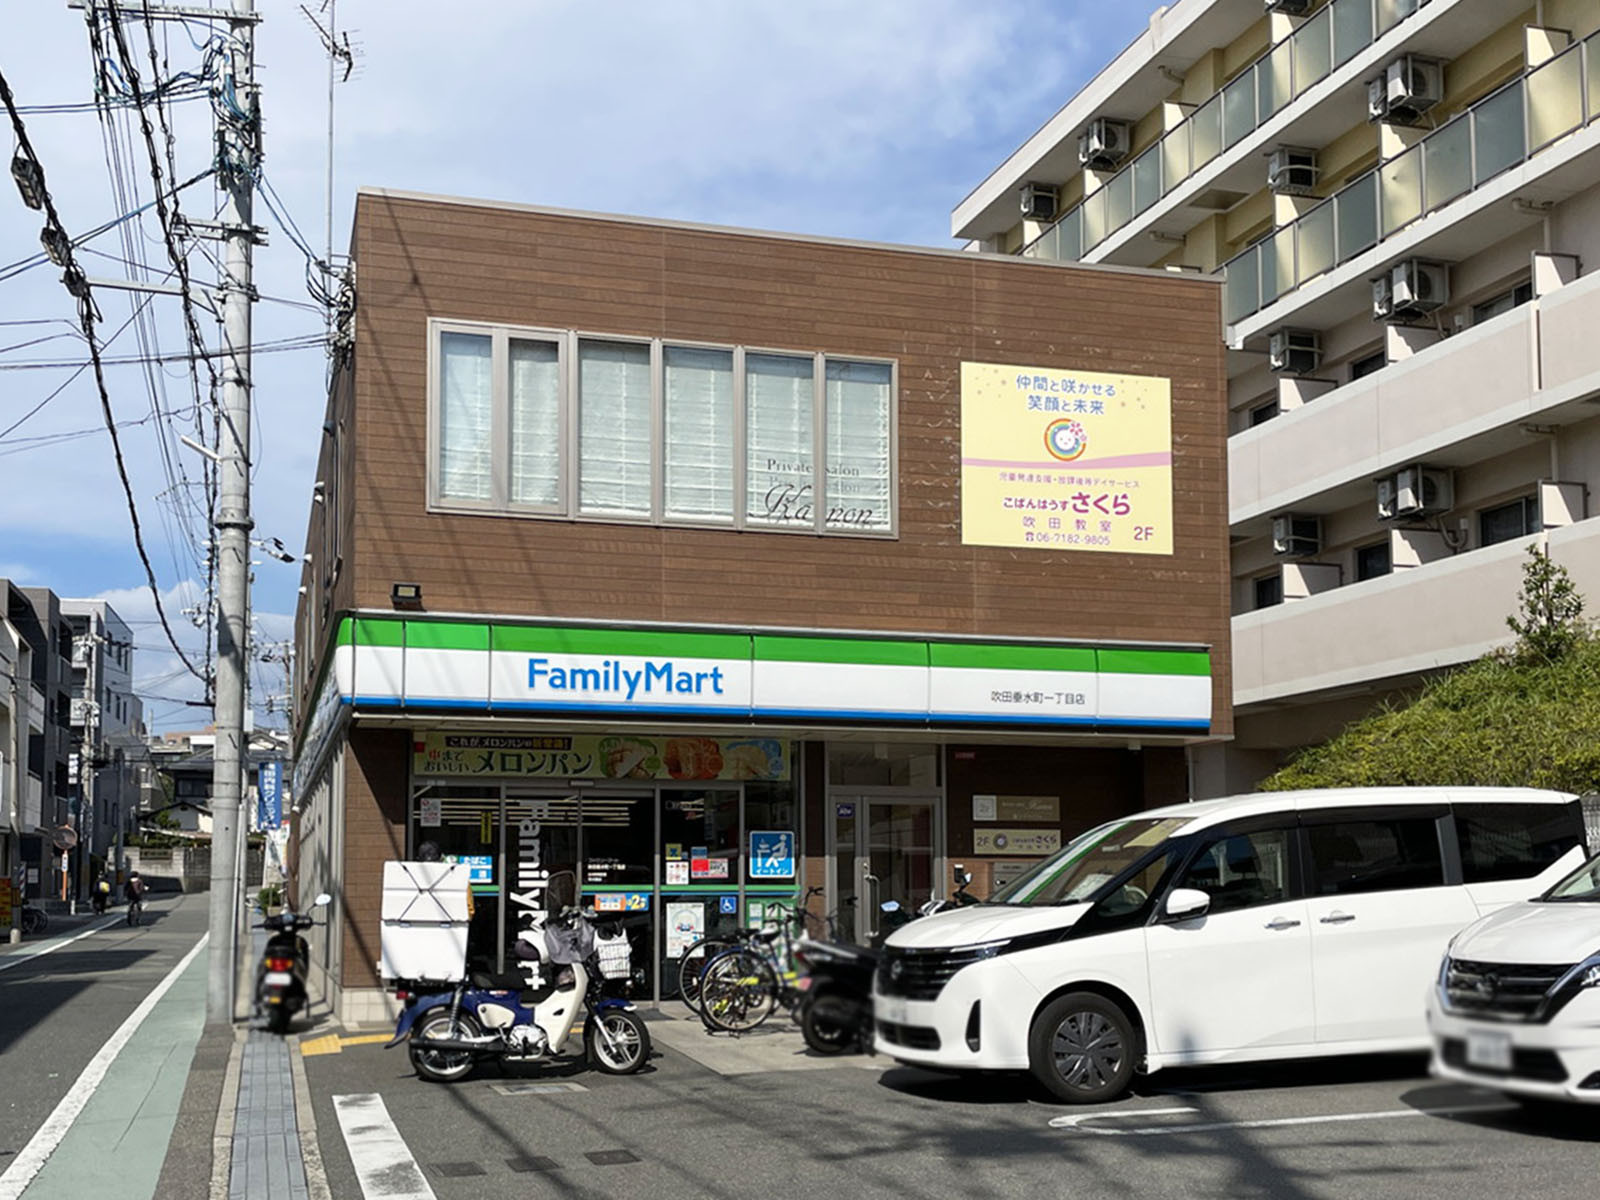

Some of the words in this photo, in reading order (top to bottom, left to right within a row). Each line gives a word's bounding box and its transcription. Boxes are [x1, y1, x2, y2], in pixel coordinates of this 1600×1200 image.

[1016, 374, 1116, 397] 仲間と咲かせる
[1028, 394, 1104, 415] 笑顔と未来
[767, 458, 813, 473] Private
[1133, 526, 1154, 541] 2F
[528, 657, 724, 701] FamilyMart
[990, 690, 1085, 705] 吹田垂水町一丁目店
[473, 750, 593, 775] メロンパン
